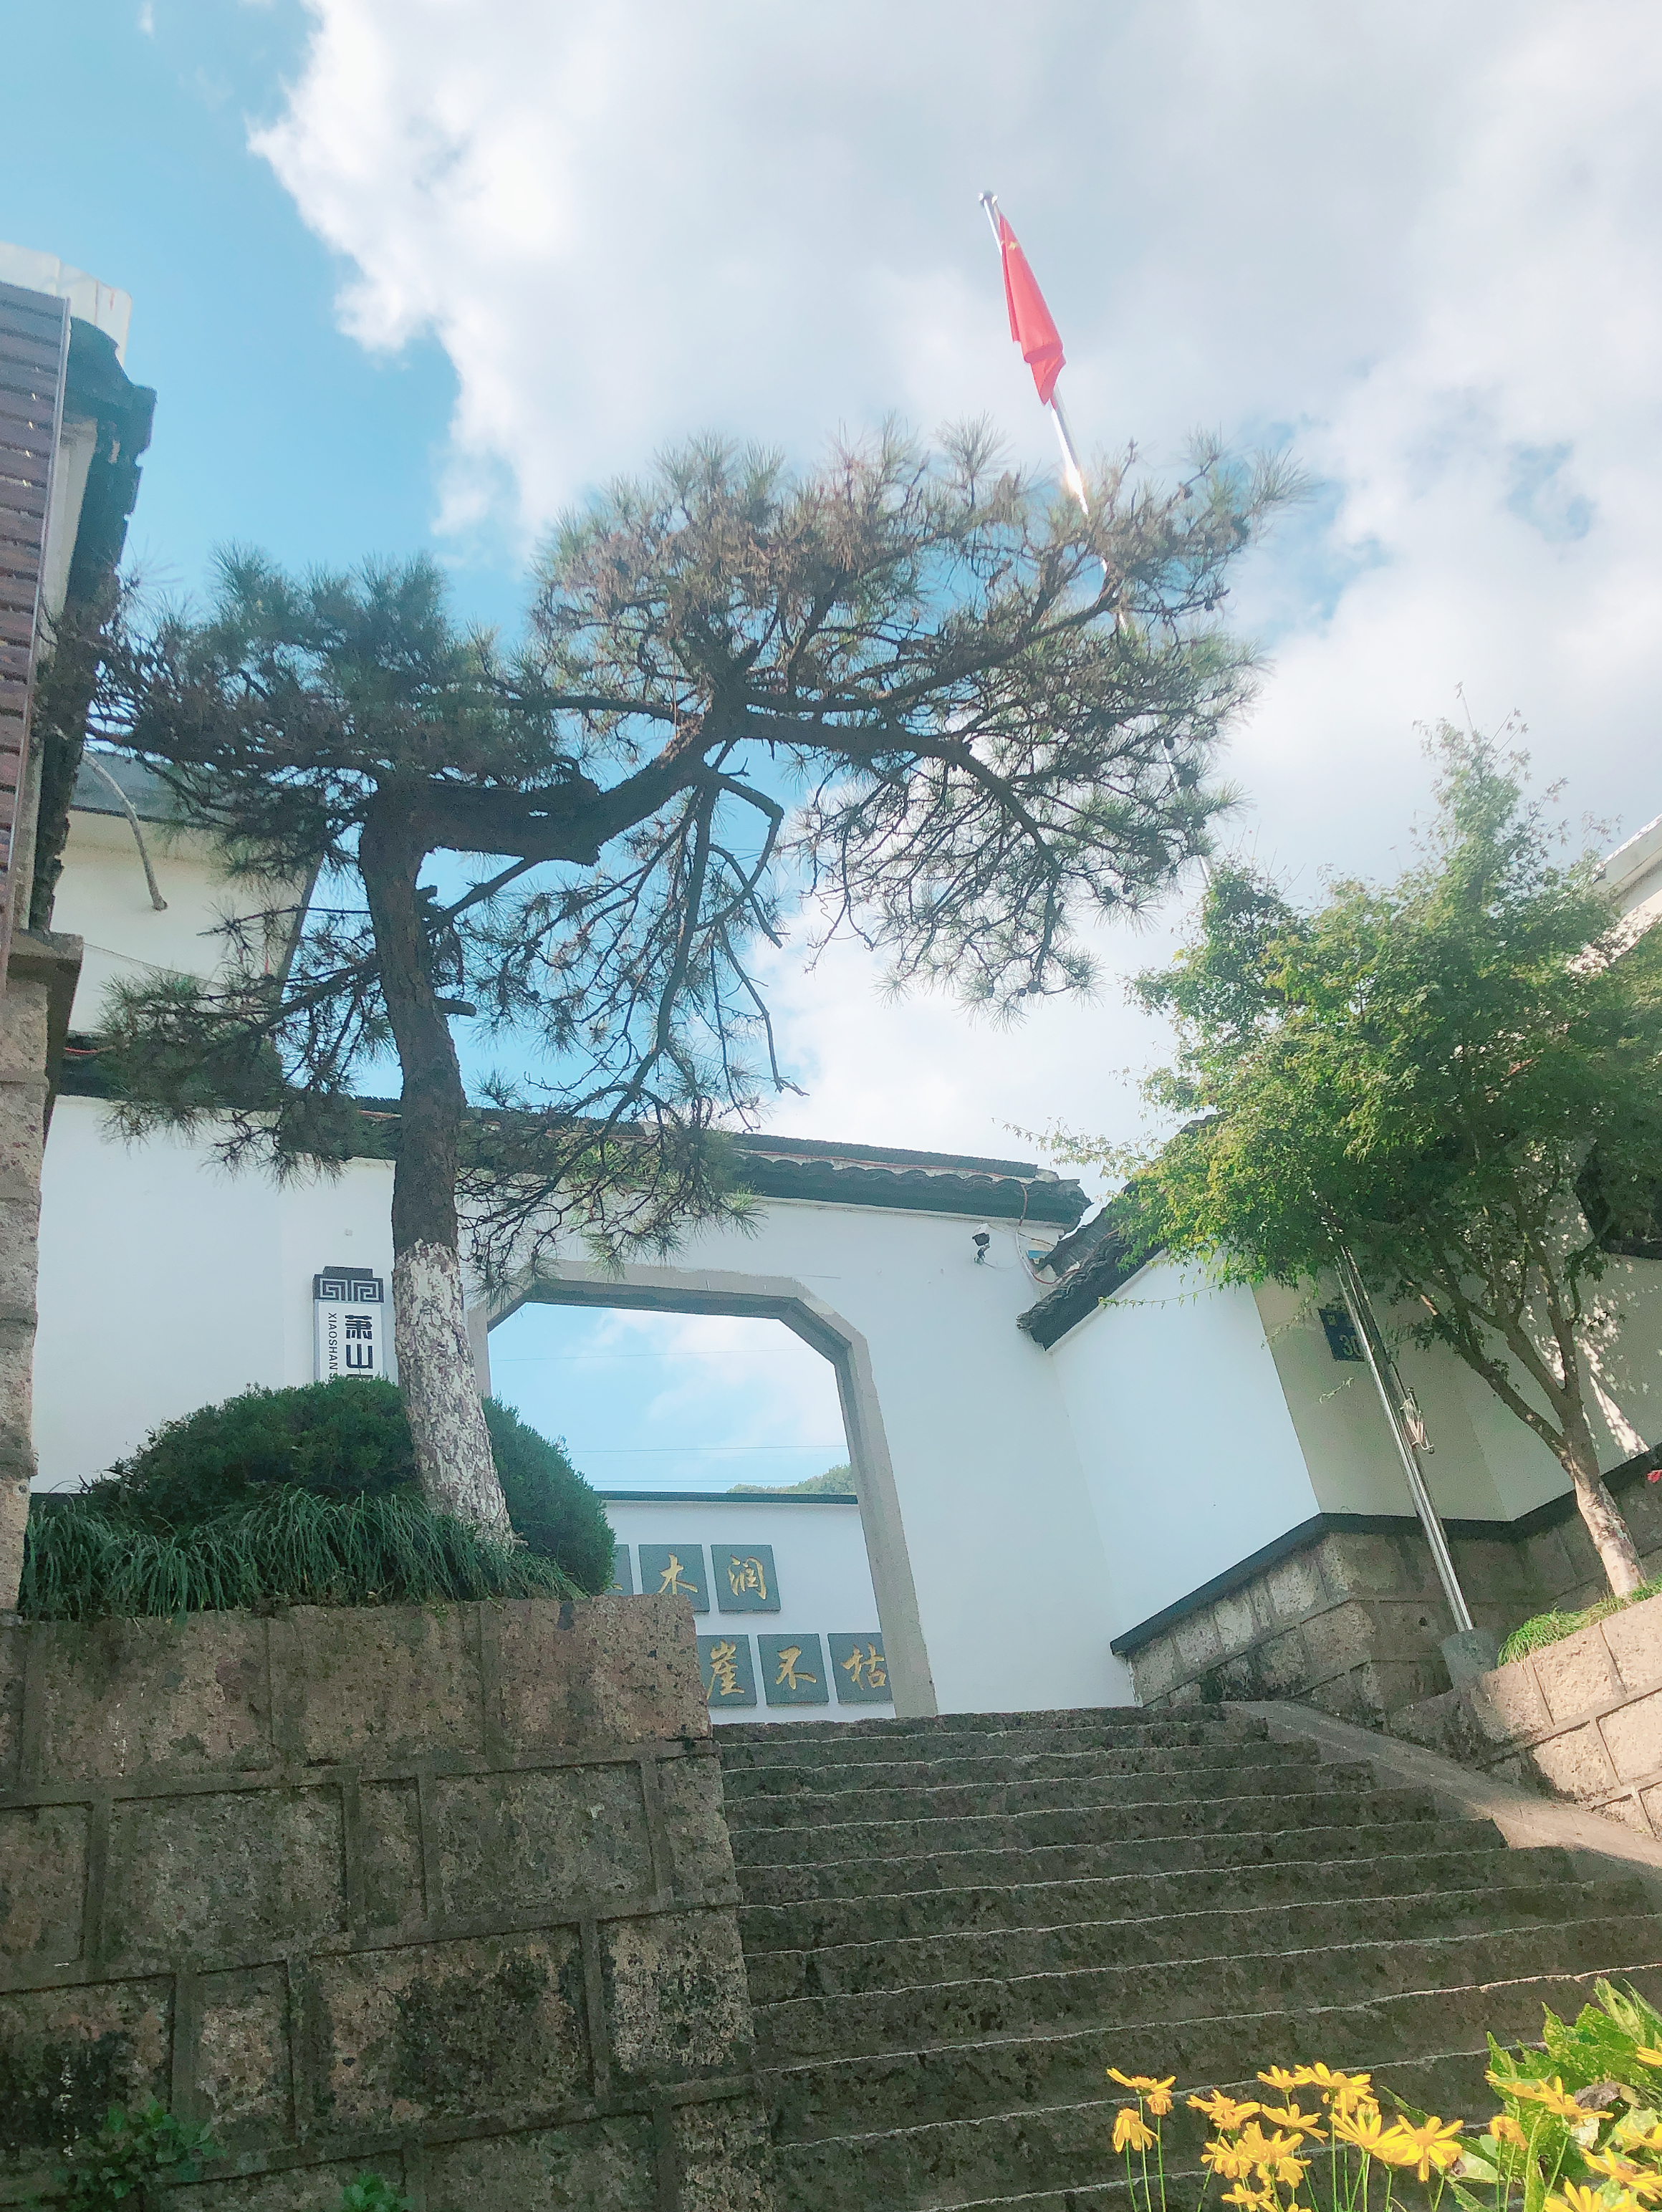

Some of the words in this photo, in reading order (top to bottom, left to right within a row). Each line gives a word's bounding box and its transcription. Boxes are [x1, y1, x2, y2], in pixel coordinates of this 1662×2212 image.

[328, 1312, 338, 1370] XIAOSHAN
[345, 1314, 373, 1379] 萧山
[611, 1552, 767, 1600] 木润
[706, 1639, 887, 1700] 崖不枯
